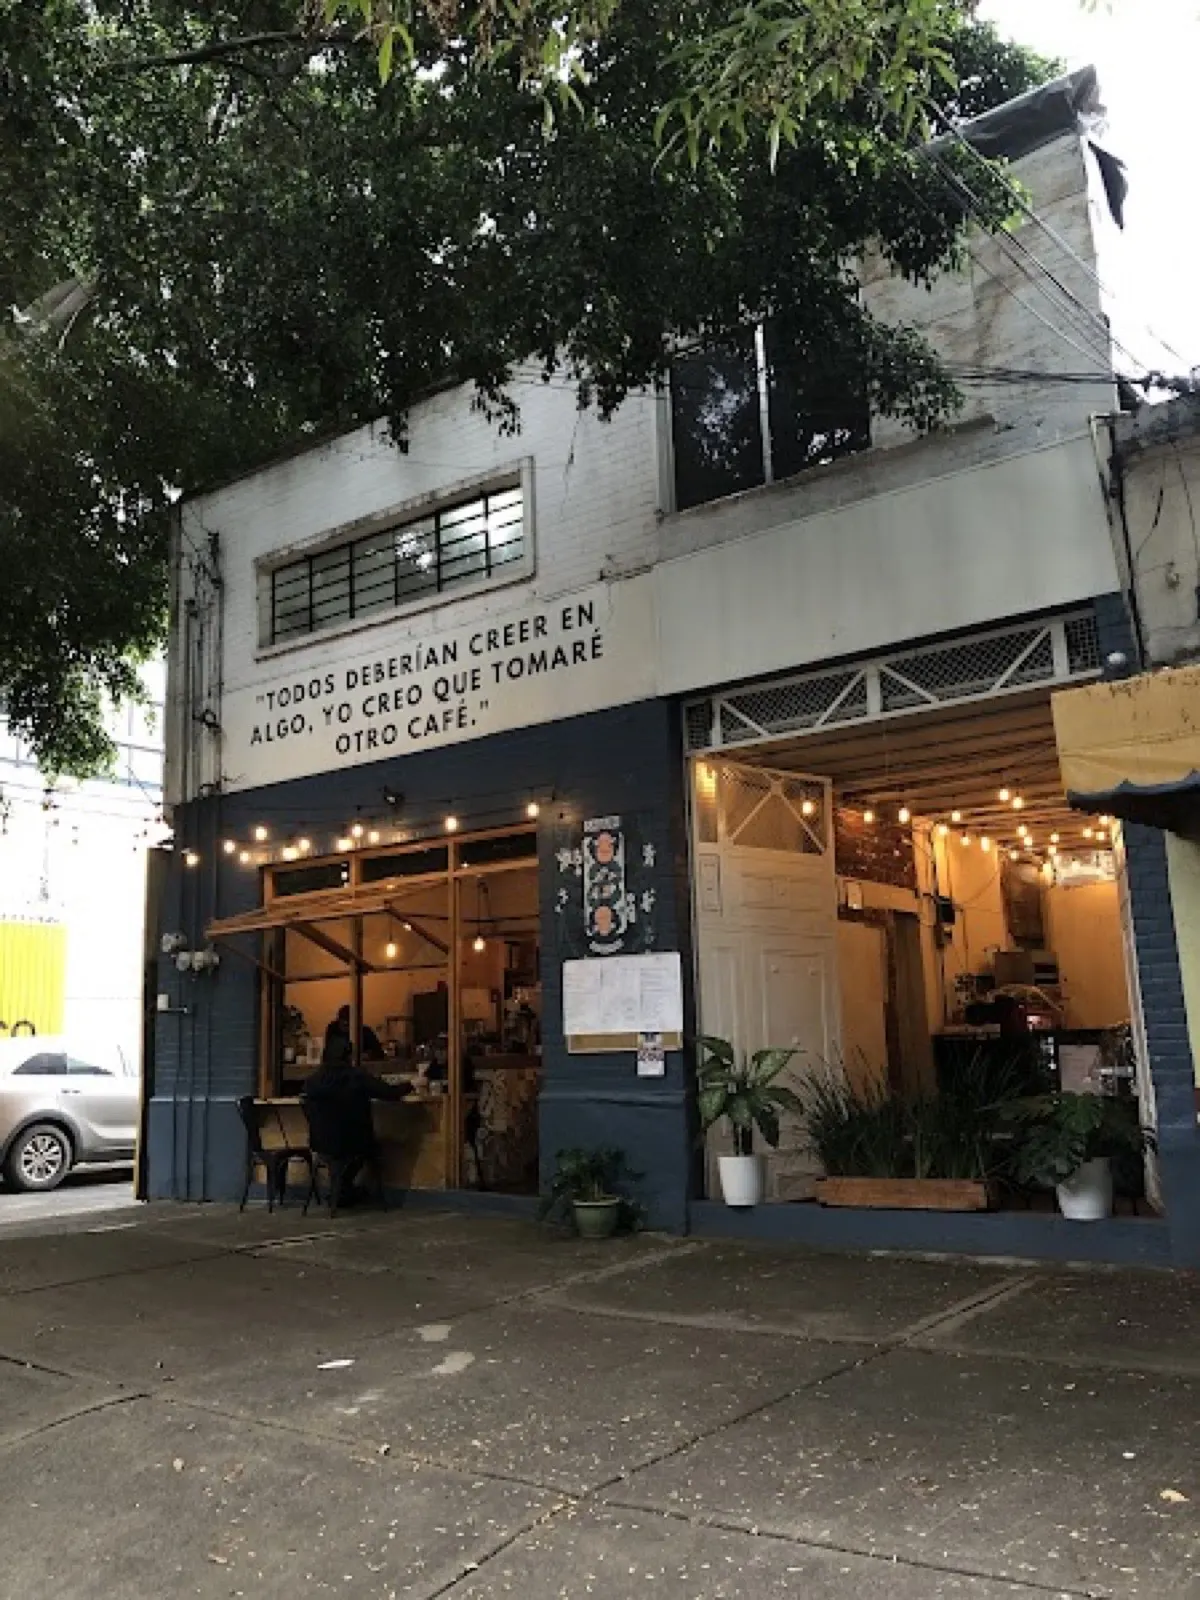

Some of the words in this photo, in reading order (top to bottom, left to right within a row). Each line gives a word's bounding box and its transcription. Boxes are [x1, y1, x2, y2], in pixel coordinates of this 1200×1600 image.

[250, 714, 313, 745] ALGO,
[322, 702, 353, 724] YO
[362, 684, 422, 717] CREO
[433, 668, 481, 701] QUE
[492, 627, 604, 682] TOMARÉ
[255, 674, 335, 711] "TODOS
[346, 640, 457, 690] DEBERÍAN
[469, 614, 548, 655] CREER
[562, 602, 594, 630] EN
[336, 725, 397, 754] OTRO
[407, 699, 489, 738] CAFÉ."
